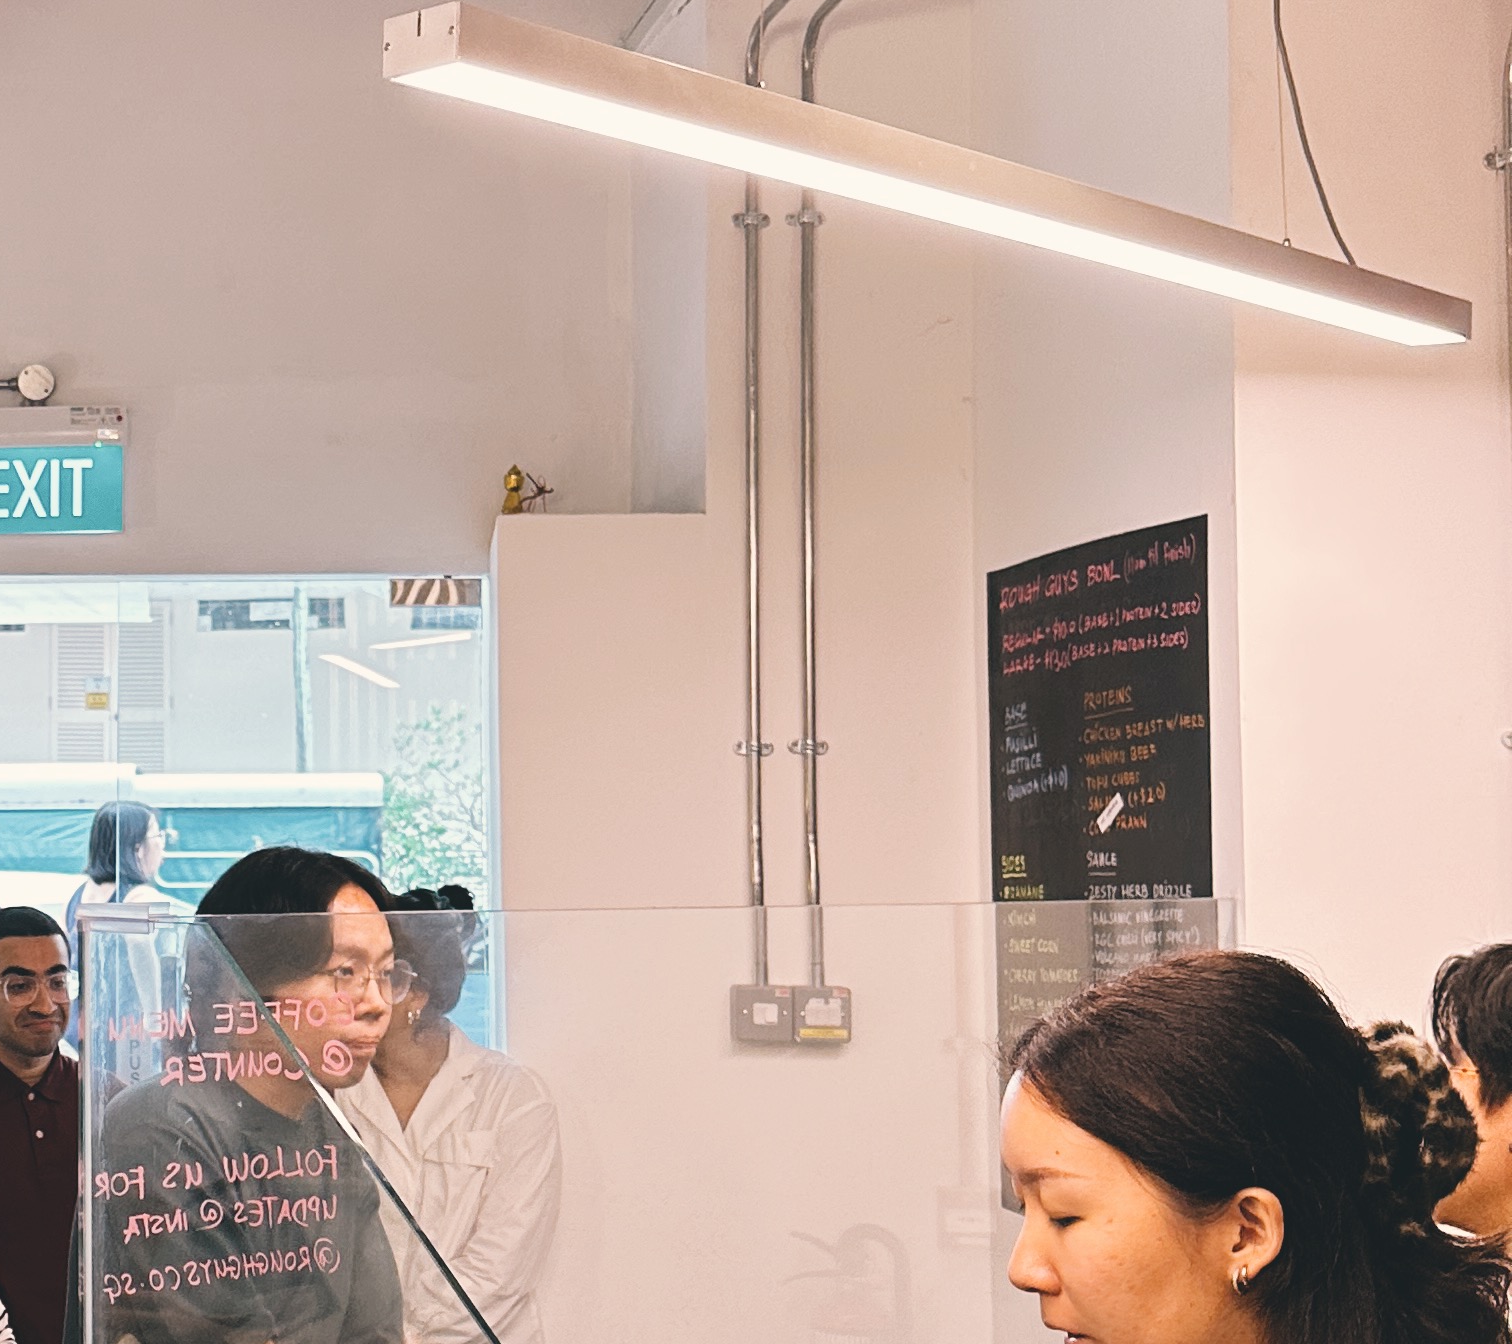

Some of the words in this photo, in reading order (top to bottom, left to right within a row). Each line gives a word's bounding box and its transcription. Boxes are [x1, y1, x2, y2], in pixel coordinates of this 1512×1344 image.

[999, 575, 1040, 615] ROUGH
[1044, 569, 1079, 599] GUYS
[1084, 685, 1132, 709] PROTEINS
[1125, 717, 1163, 740] BREAST
[1086, 849, 1118, 868] SAUCE
[1089, 884, 1118, 900] ZESTY
[1121, 883, 1149, 899] HERB
[1152, 879, 1193, 899] DRIZZLE
